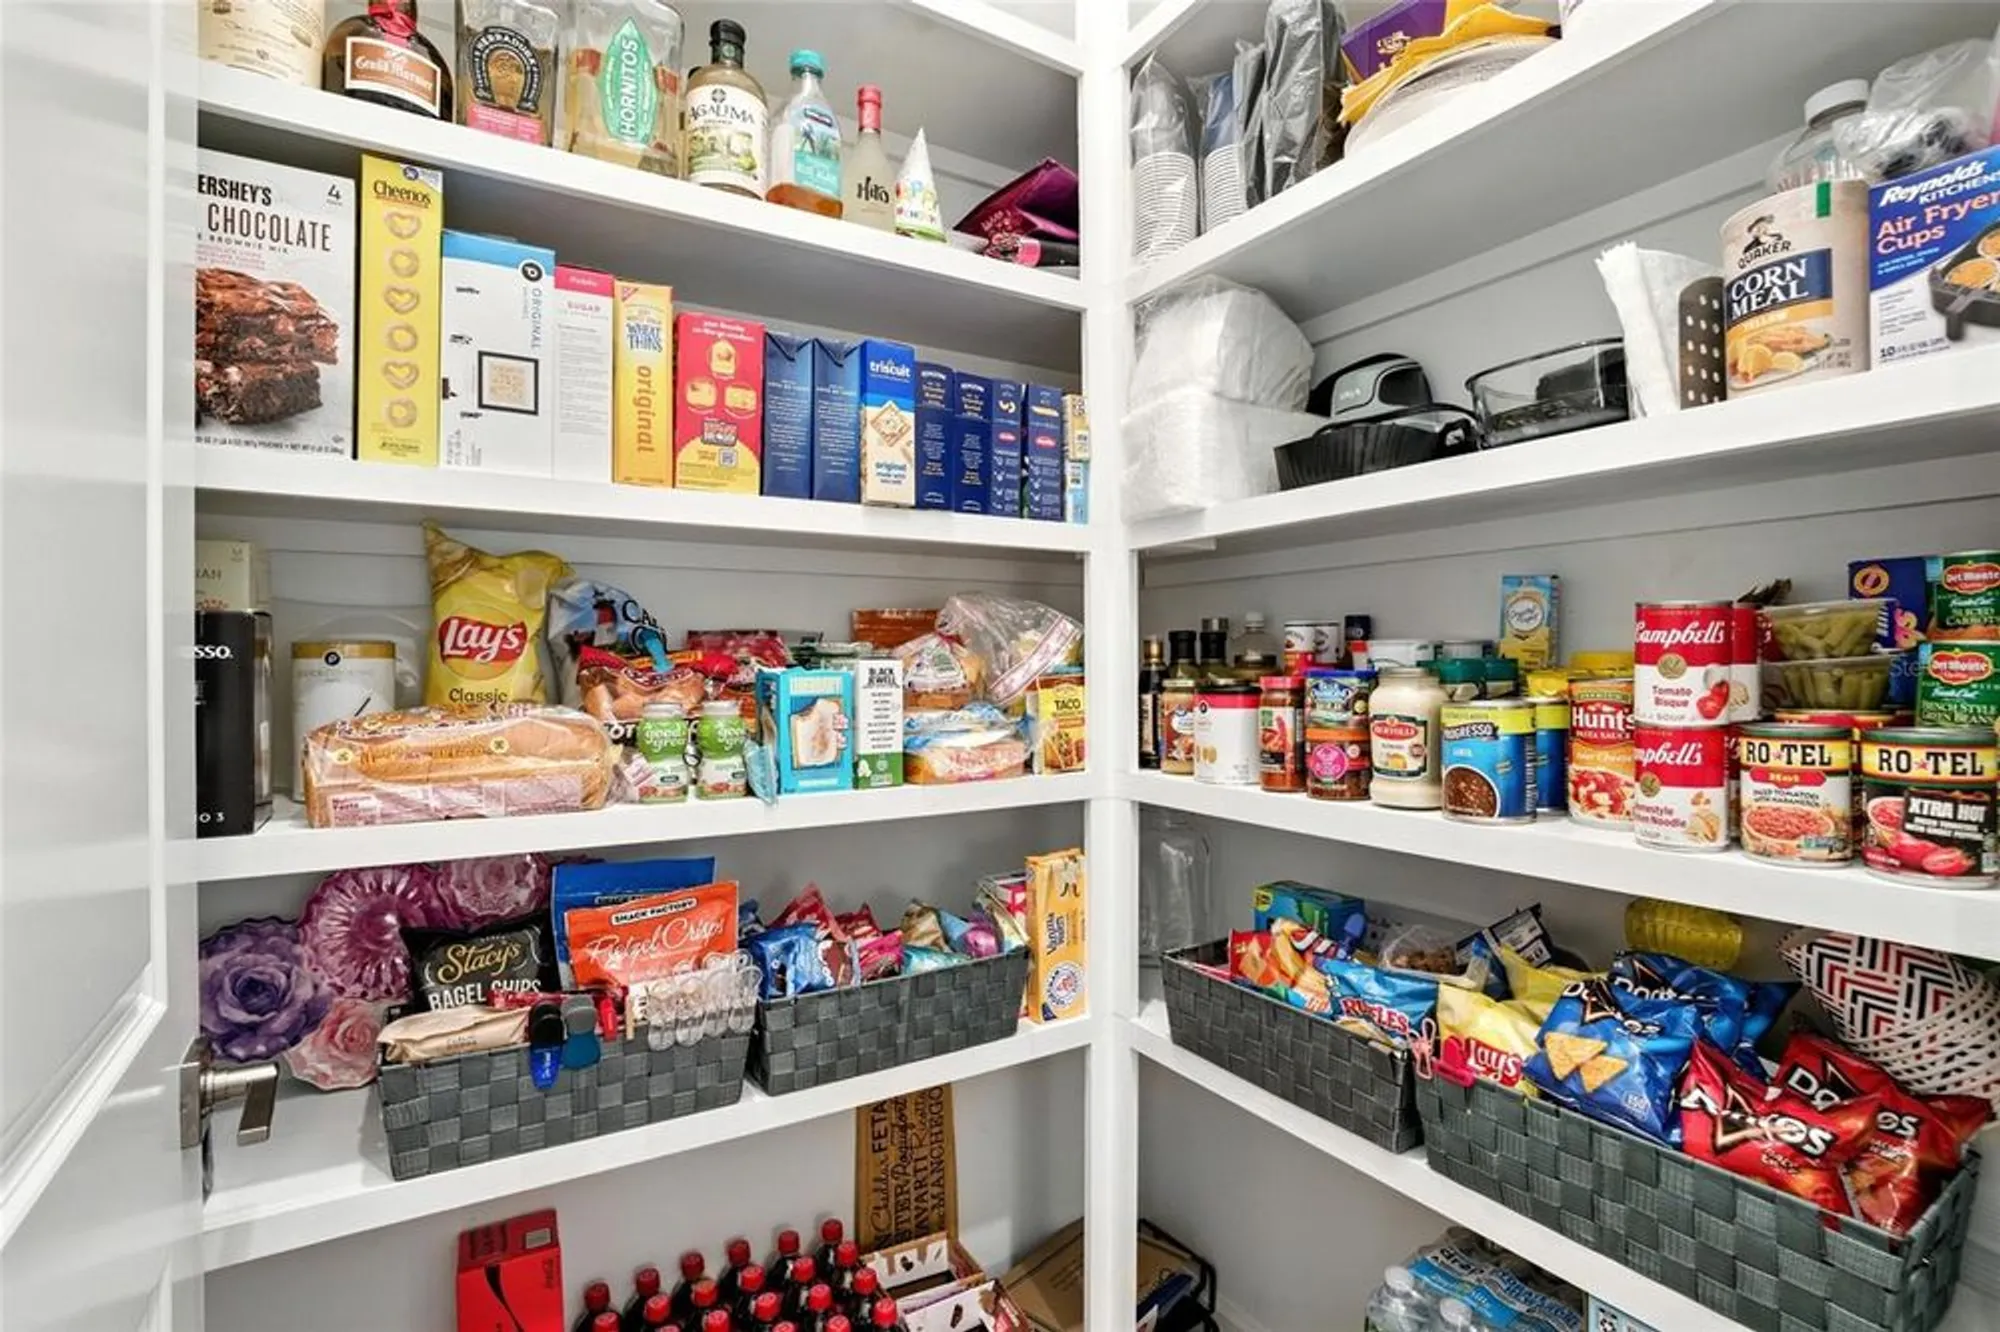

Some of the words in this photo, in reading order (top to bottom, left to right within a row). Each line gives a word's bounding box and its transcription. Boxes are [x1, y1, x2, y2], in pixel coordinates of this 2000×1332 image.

[619, 37, 639, 140] HORNITOS
[197, 174, 273, 206] ERSHEY'S
[327, 184, 342, 201] 4
[1878, 161, 1988, 207] Reynolds
[208, 202, 332, 252] CHOCOLATE
[1876, 216, 1917, 240] Air
[1924, 191, 2000, 225] Fryer
[1738, 240, 1791, 270] QUAKER
[1877, 224, 1946, 255] Cups
[1732, 258, 1808, 301] CORN
[1732, 280, 1809, 320] MEAL
[531, 287, 543, 350] ORIGINAL
[1880, 346, 1896, 359] 10
[869, 359, 912, 379] triscuit
[633, 365, 656, 454] original
[443, 618, 524, 664] Lay's
[1635, 620, 1726, 649] Campbell's
[868, 667, 894, 676] BLACK
[448, 687, 509, 704] Classic
[1054, 698, 1082, 710] TACO
[1652, 685, 1693, 697] Tomato
[1653, 698, 1690, 709] Bisque
[1572, 706, 1637, 732] Hunt's
[1634, 741, 1704, 768] mpbell's
[1908, 797, 1954, 820] XTRA
[1957, 803, 1987, 823] HOT
[584, 926, 662, 970] Pretzel
[662, 916, 725, 950] Crisps
[437, 942, 522, 984] Stacy's
[428, 982, 488, 1013] BAGEL
[872, 1100, 889, 1153] FETA
[928, 1086, 945, 1212] MANCHEGO
[913, 1154, 930, 1236] AVARTI
